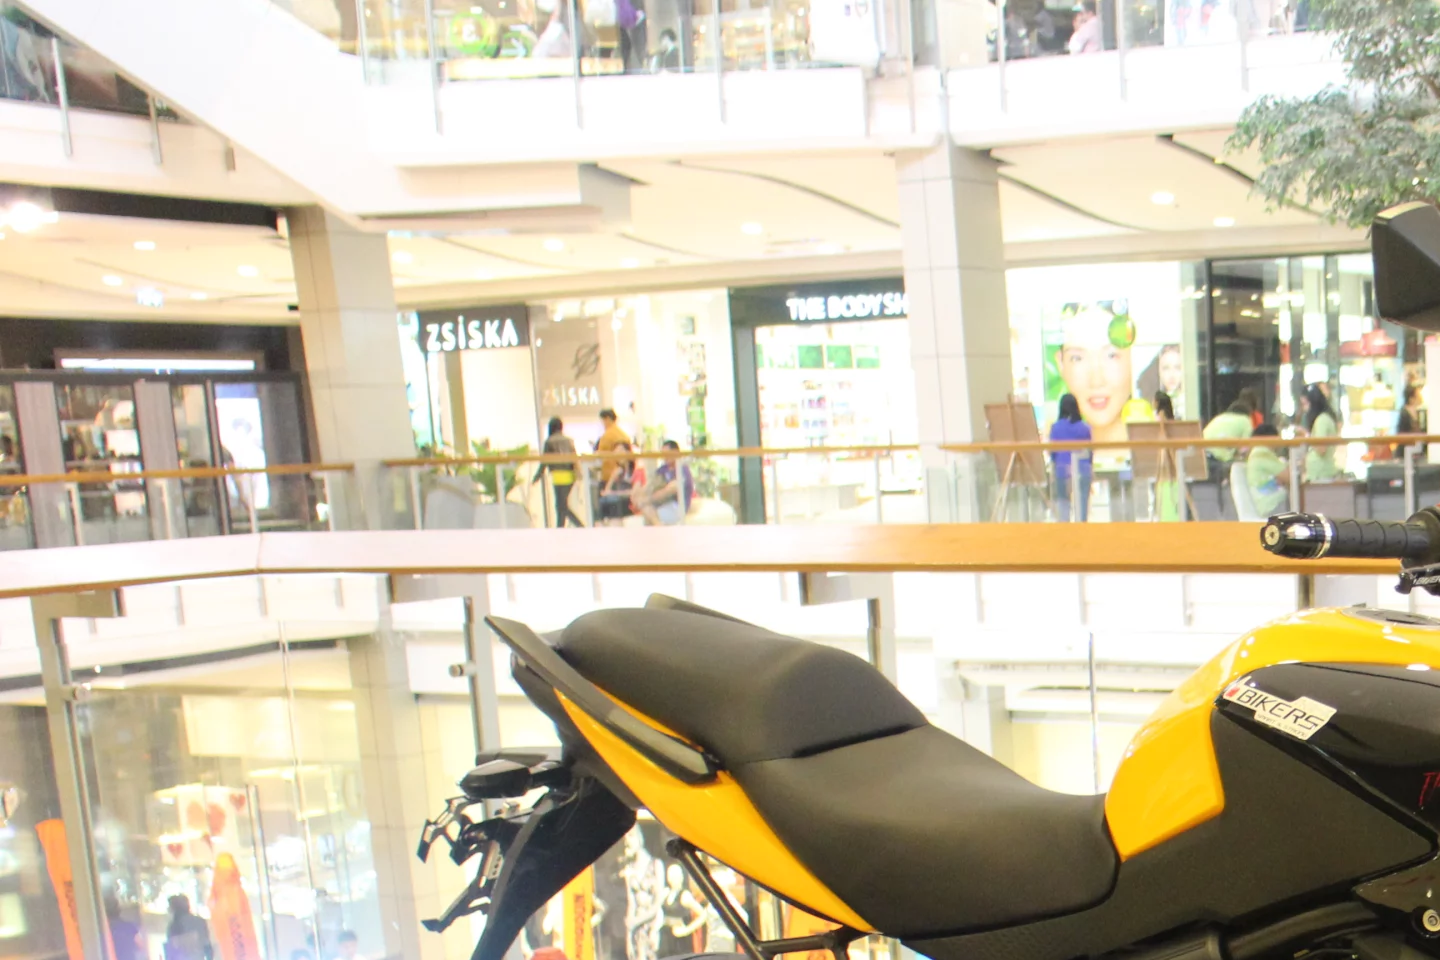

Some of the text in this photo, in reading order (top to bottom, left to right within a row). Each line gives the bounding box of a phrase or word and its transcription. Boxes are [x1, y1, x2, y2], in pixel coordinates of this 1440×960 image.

[786, 297, 826, 321] THE
[827, 293, 882, 319] BODY
[1236, 689, 1325, 731] BIKERS
